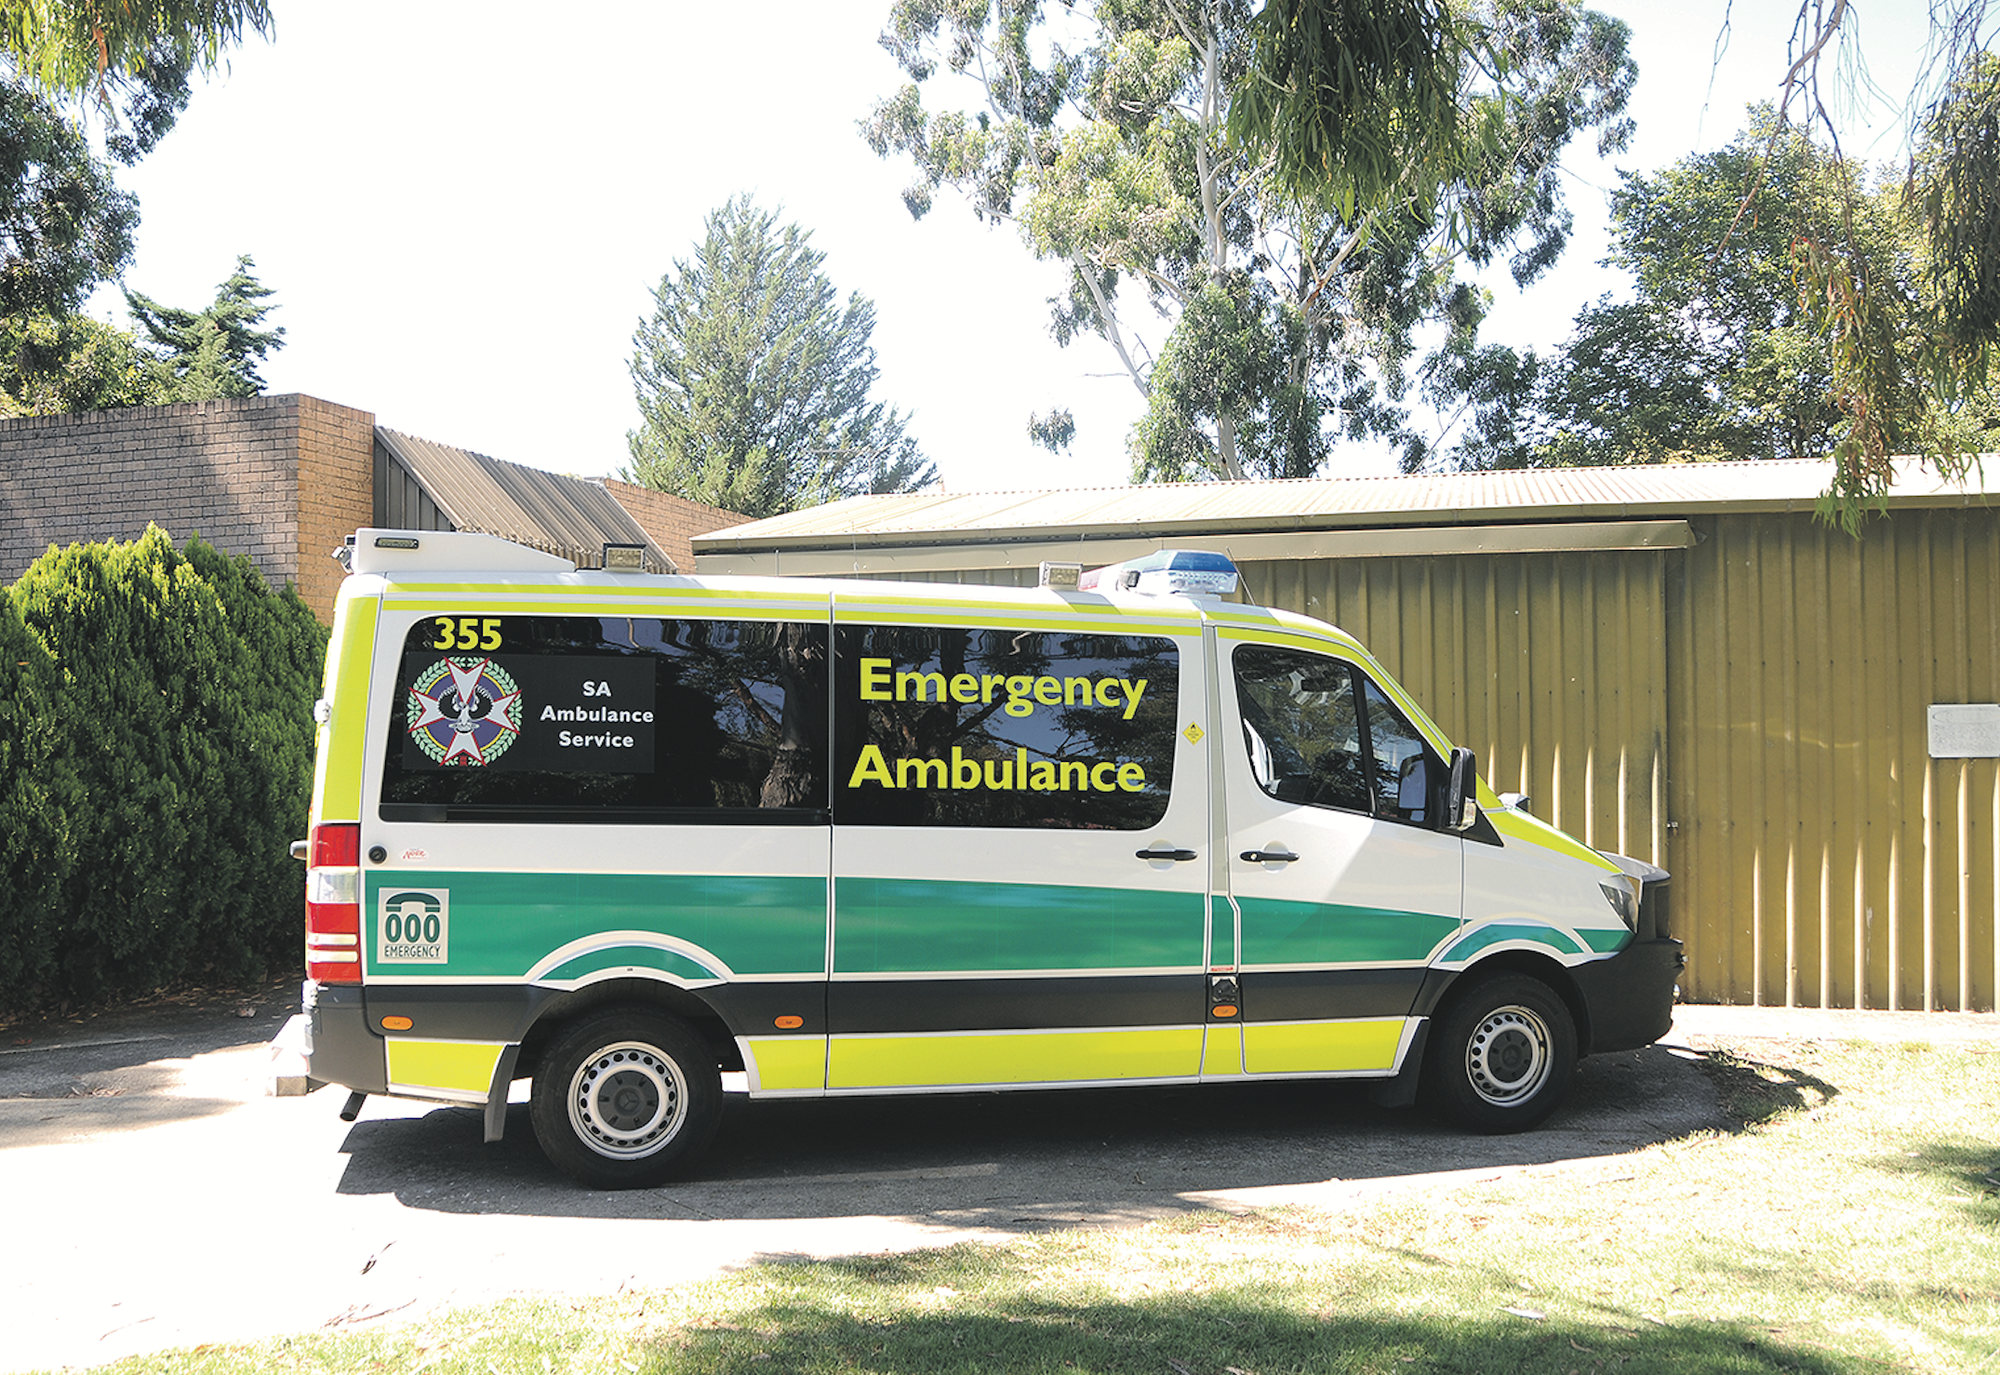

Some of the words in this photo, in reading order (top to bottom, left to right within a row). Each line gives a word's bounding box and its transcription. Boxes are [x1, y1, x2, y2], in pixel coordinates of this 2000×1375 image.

[433, 617, 502, 651] 355
[582, 681, 612, 697] SA
[860, 657, 1148, 720] Emergency
[540, 705, 654, 723] Ambulance
[558, 731, 635, 747] Service
[848, 744, 1146, 792] Ambulance
[385, 913, 441, 943] 000
[384, 945, 441, 958] EMERGENCY
